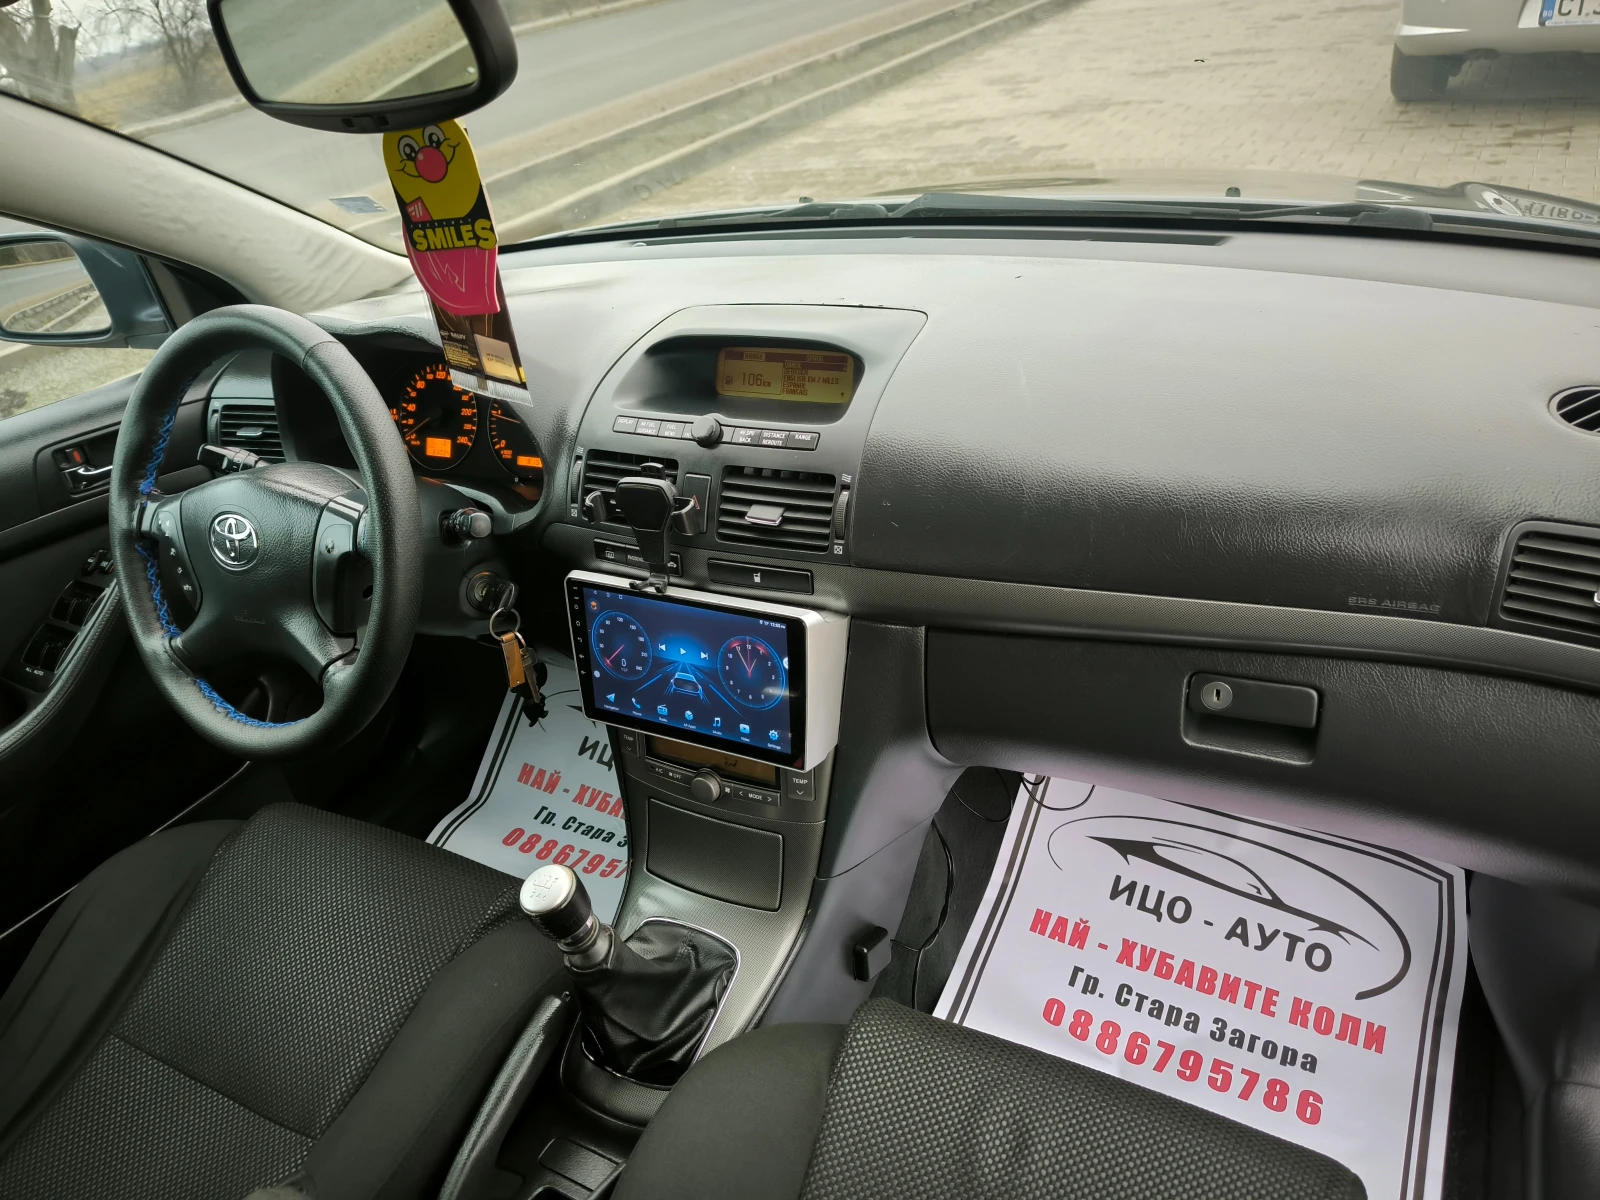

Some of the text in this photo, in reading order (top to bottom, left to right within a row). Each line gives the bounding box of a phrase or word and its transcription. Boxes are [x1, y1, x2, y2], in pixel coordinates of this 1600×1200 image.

[412, 218, 497, 252] SMILES
[744, 352, 765, 361] RANGE
[436, 371, 446, 379] 120
[461, 408, 472, 416] 200
[637, 427, 656, 435] GUIDANCE
[763, 431, 786, 439] DISTANCE
[794, 433, 812, 441] RANGE
[1348, 596, 1441, 612] SRS AIRBAG
[792, 777, 808, 785] TEMP
[516, 762, 562, 794] НАЙ
[571, 783, 626, 820] ХУБА
[748, 792, 763, 801] MODE
[533, 805, 557, 827] Гр.
[561, 815, 616, 844] Стара
[1109, 874, 1193, 924] ИЦО
[1224, 916, 1333, 973] АУТО
[1028, 908, 1091, 951] НАЙ
[1115, 937, 1280, 1018] ХУБАВИТЕ
[1288, 996, 1388, 1055] КОЛИ
[1067, 965, 1318, 1074] Гр. Стара Загора
[1042, 997, 1324, 1126] 0886795786
